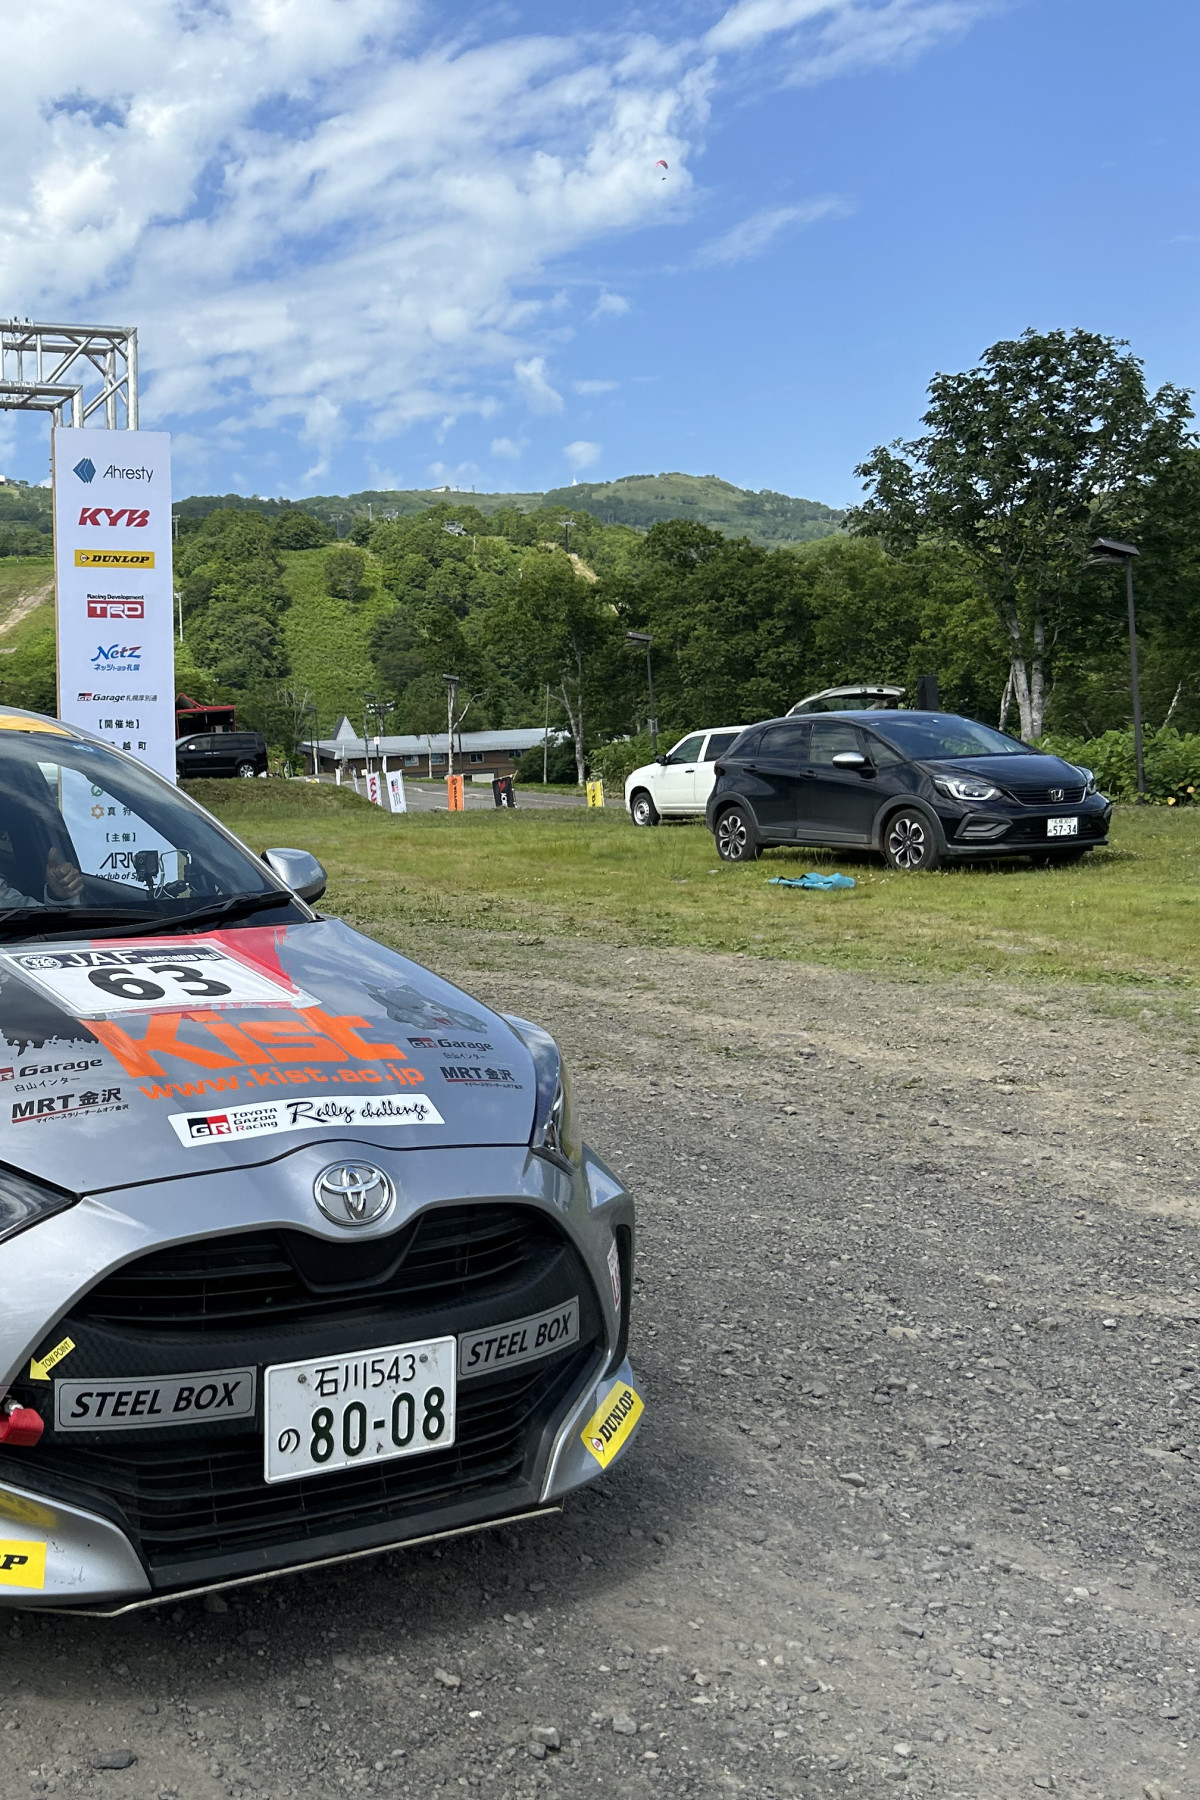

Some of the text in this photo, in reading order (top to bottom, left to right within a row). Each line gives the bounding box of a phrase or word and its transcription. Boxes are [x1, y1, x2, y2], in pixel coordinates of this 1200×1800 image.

[103, 465, 153, 482] Ahresty
[79, 508, 150, 527] KYB
[91, 555, 150, 564] DUNLOP
[89, 603, 142, 618] TRD
[92, 694, 125, 702] Garage
[67, 951, 138, 967] JAF
[88, 965, 232, 1000] 63
[437, 1039, 493, 1051] Garage
[19, 1059, 103, 1077] Garage
[14, 1077, 81, 1092] 白山インター
[139, 1062, 424, 1100] www.kist.ac.jp
[230, 1108, 278, 1118] TOYOTA
[233, 1114, 276, 1125] GAZOO
[287, 1101, 429, 1124] Rally challenge
[189, 1119, 231, 1138] GR
[235, 1121, 278, 1132] Racing
[466, 1312, 573, 1368] STEEL BOX
[41, 1340, 72, 1370] TOW POINT
[71, 1380, 241, 1418] STEEL BOX
[278, 1386, 445, 1463] の 80-08
[598, 1390, 635, 1443] DUNLOP
